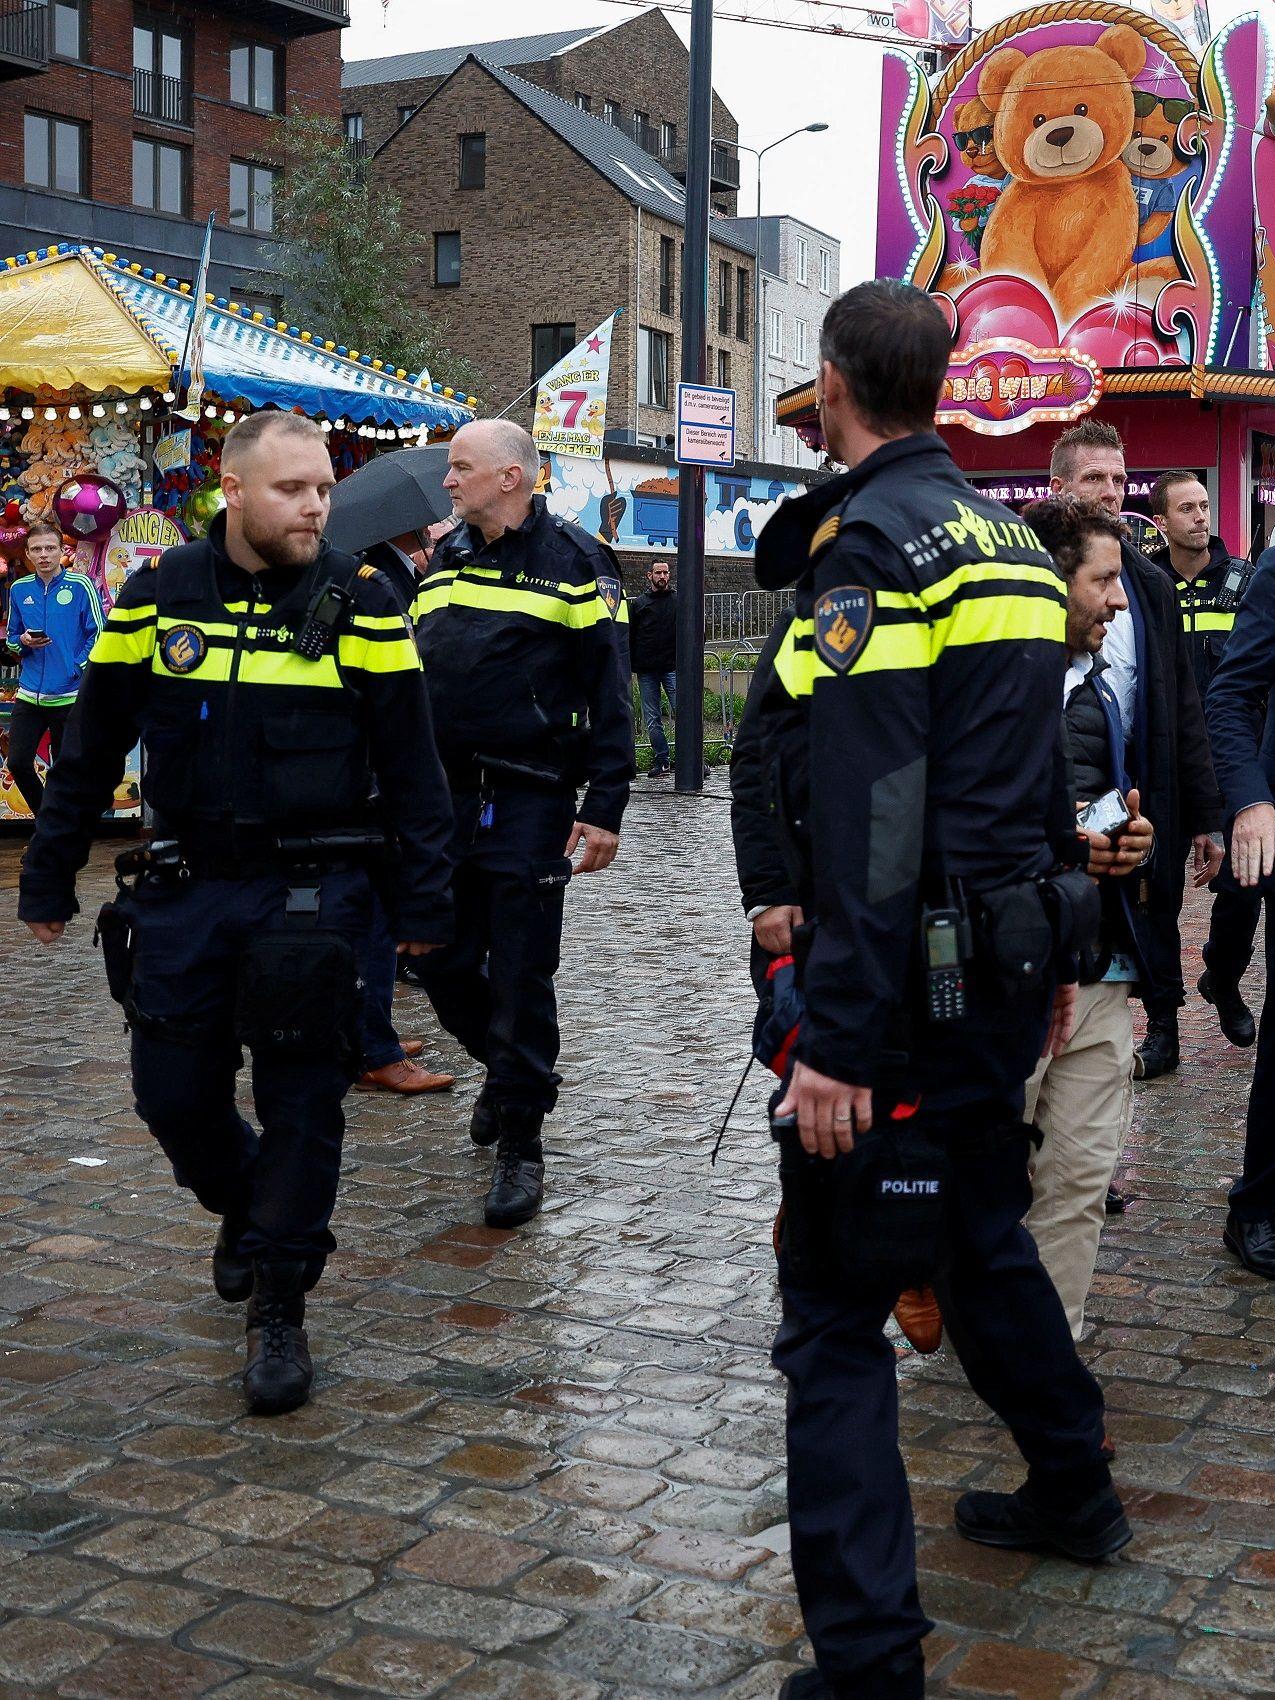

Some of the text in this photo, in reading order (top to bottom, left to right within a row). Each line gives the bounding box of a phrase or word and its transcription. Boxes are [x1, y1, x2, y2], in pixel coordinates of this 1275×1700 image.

[546, 370, 600, 391] VANG ER
[952, 375, 1048, 402] BIG WIN
[560, 391, 588, 428] 7
[538, 431, 590, 443] EN JE MAG
[119, 513, 180, 547] VANG ER
[516, 570, 549, 587] OLITIE
[882, 1180, 940, 1194] POLITIE
